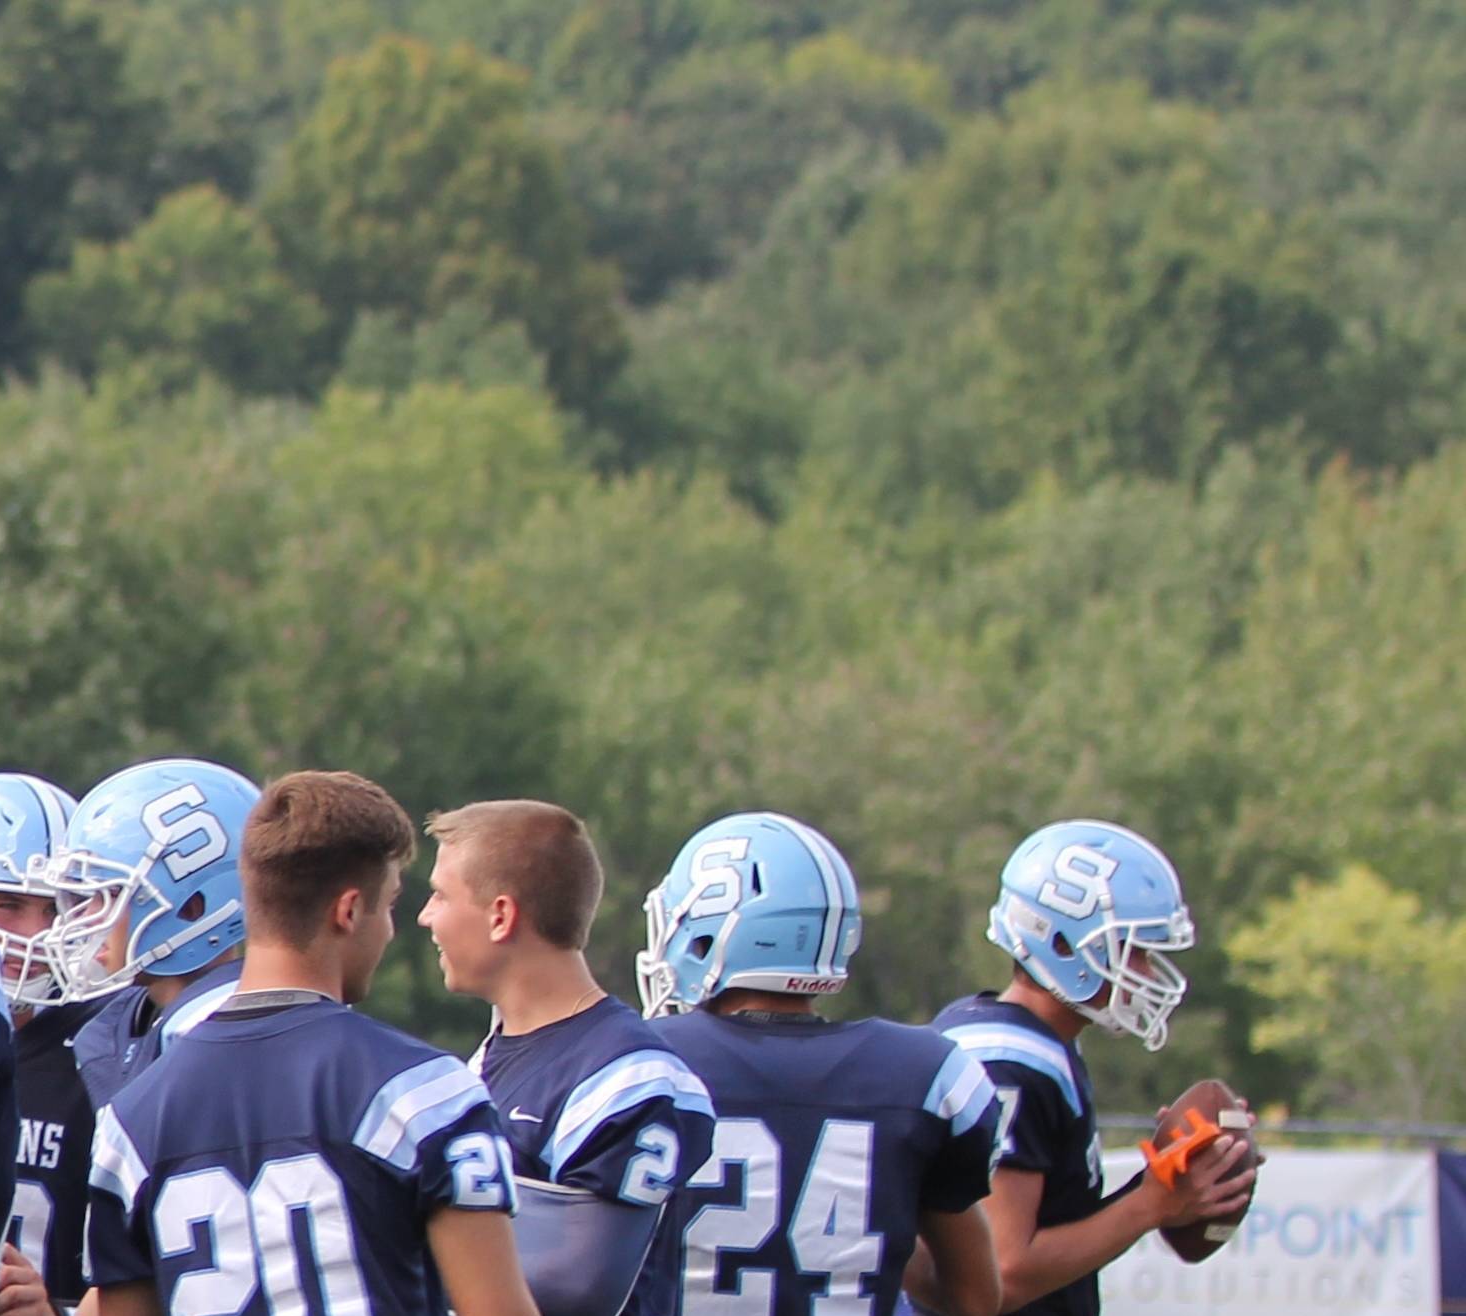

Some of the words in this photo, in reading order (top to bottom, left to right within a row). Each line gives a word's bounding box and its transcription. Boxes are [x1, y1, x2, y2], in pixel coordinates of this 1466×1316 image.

[141, 782, 229, 882] S
[689, 837, 752, 922] S
[1037, 843, 1120, 922] S
[618, 1122, 681, 1209] 2
